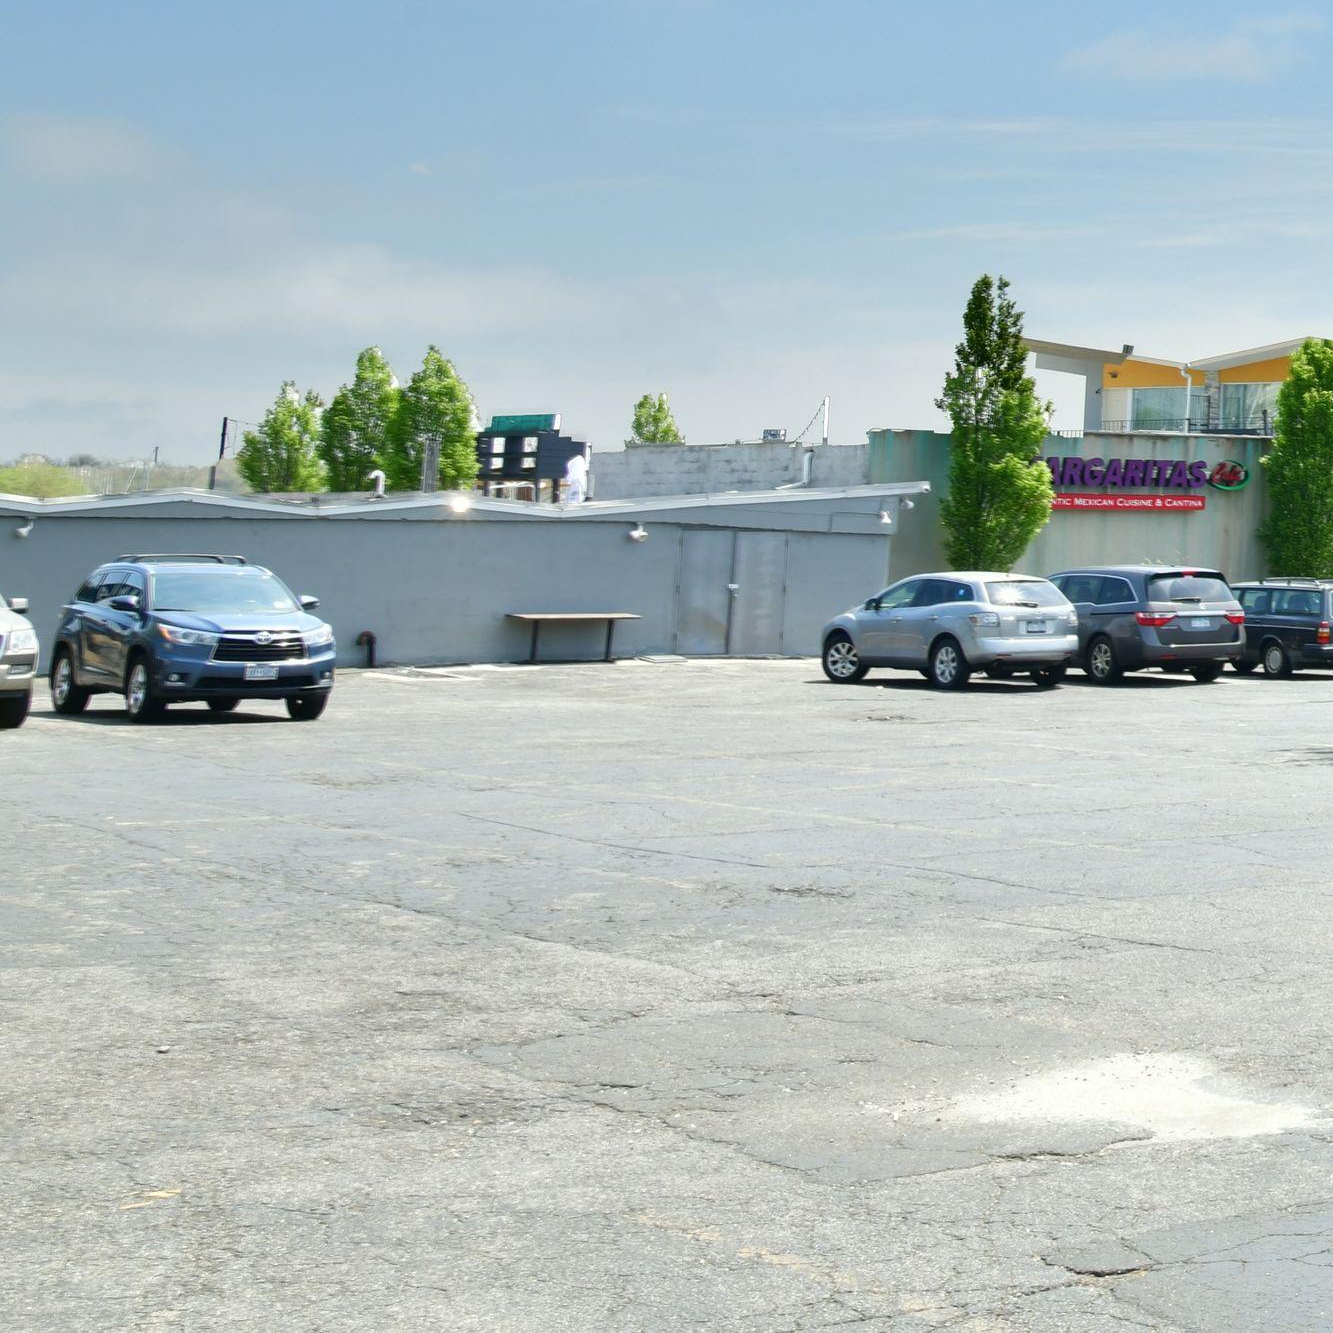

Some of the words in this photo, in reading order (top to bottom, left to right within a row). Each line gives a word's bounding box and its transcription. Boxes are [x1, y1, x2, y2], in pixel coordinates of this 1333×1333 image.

[1033, 456, 1208, 488] ARGARITAS
[1073, 497, 1114, 507] MEXICAN
[1116, 498, 1154, 508] CUISINE
[1155, 499, 1163, 507] &
[1164, 498, 1203, 508] CANTINA
